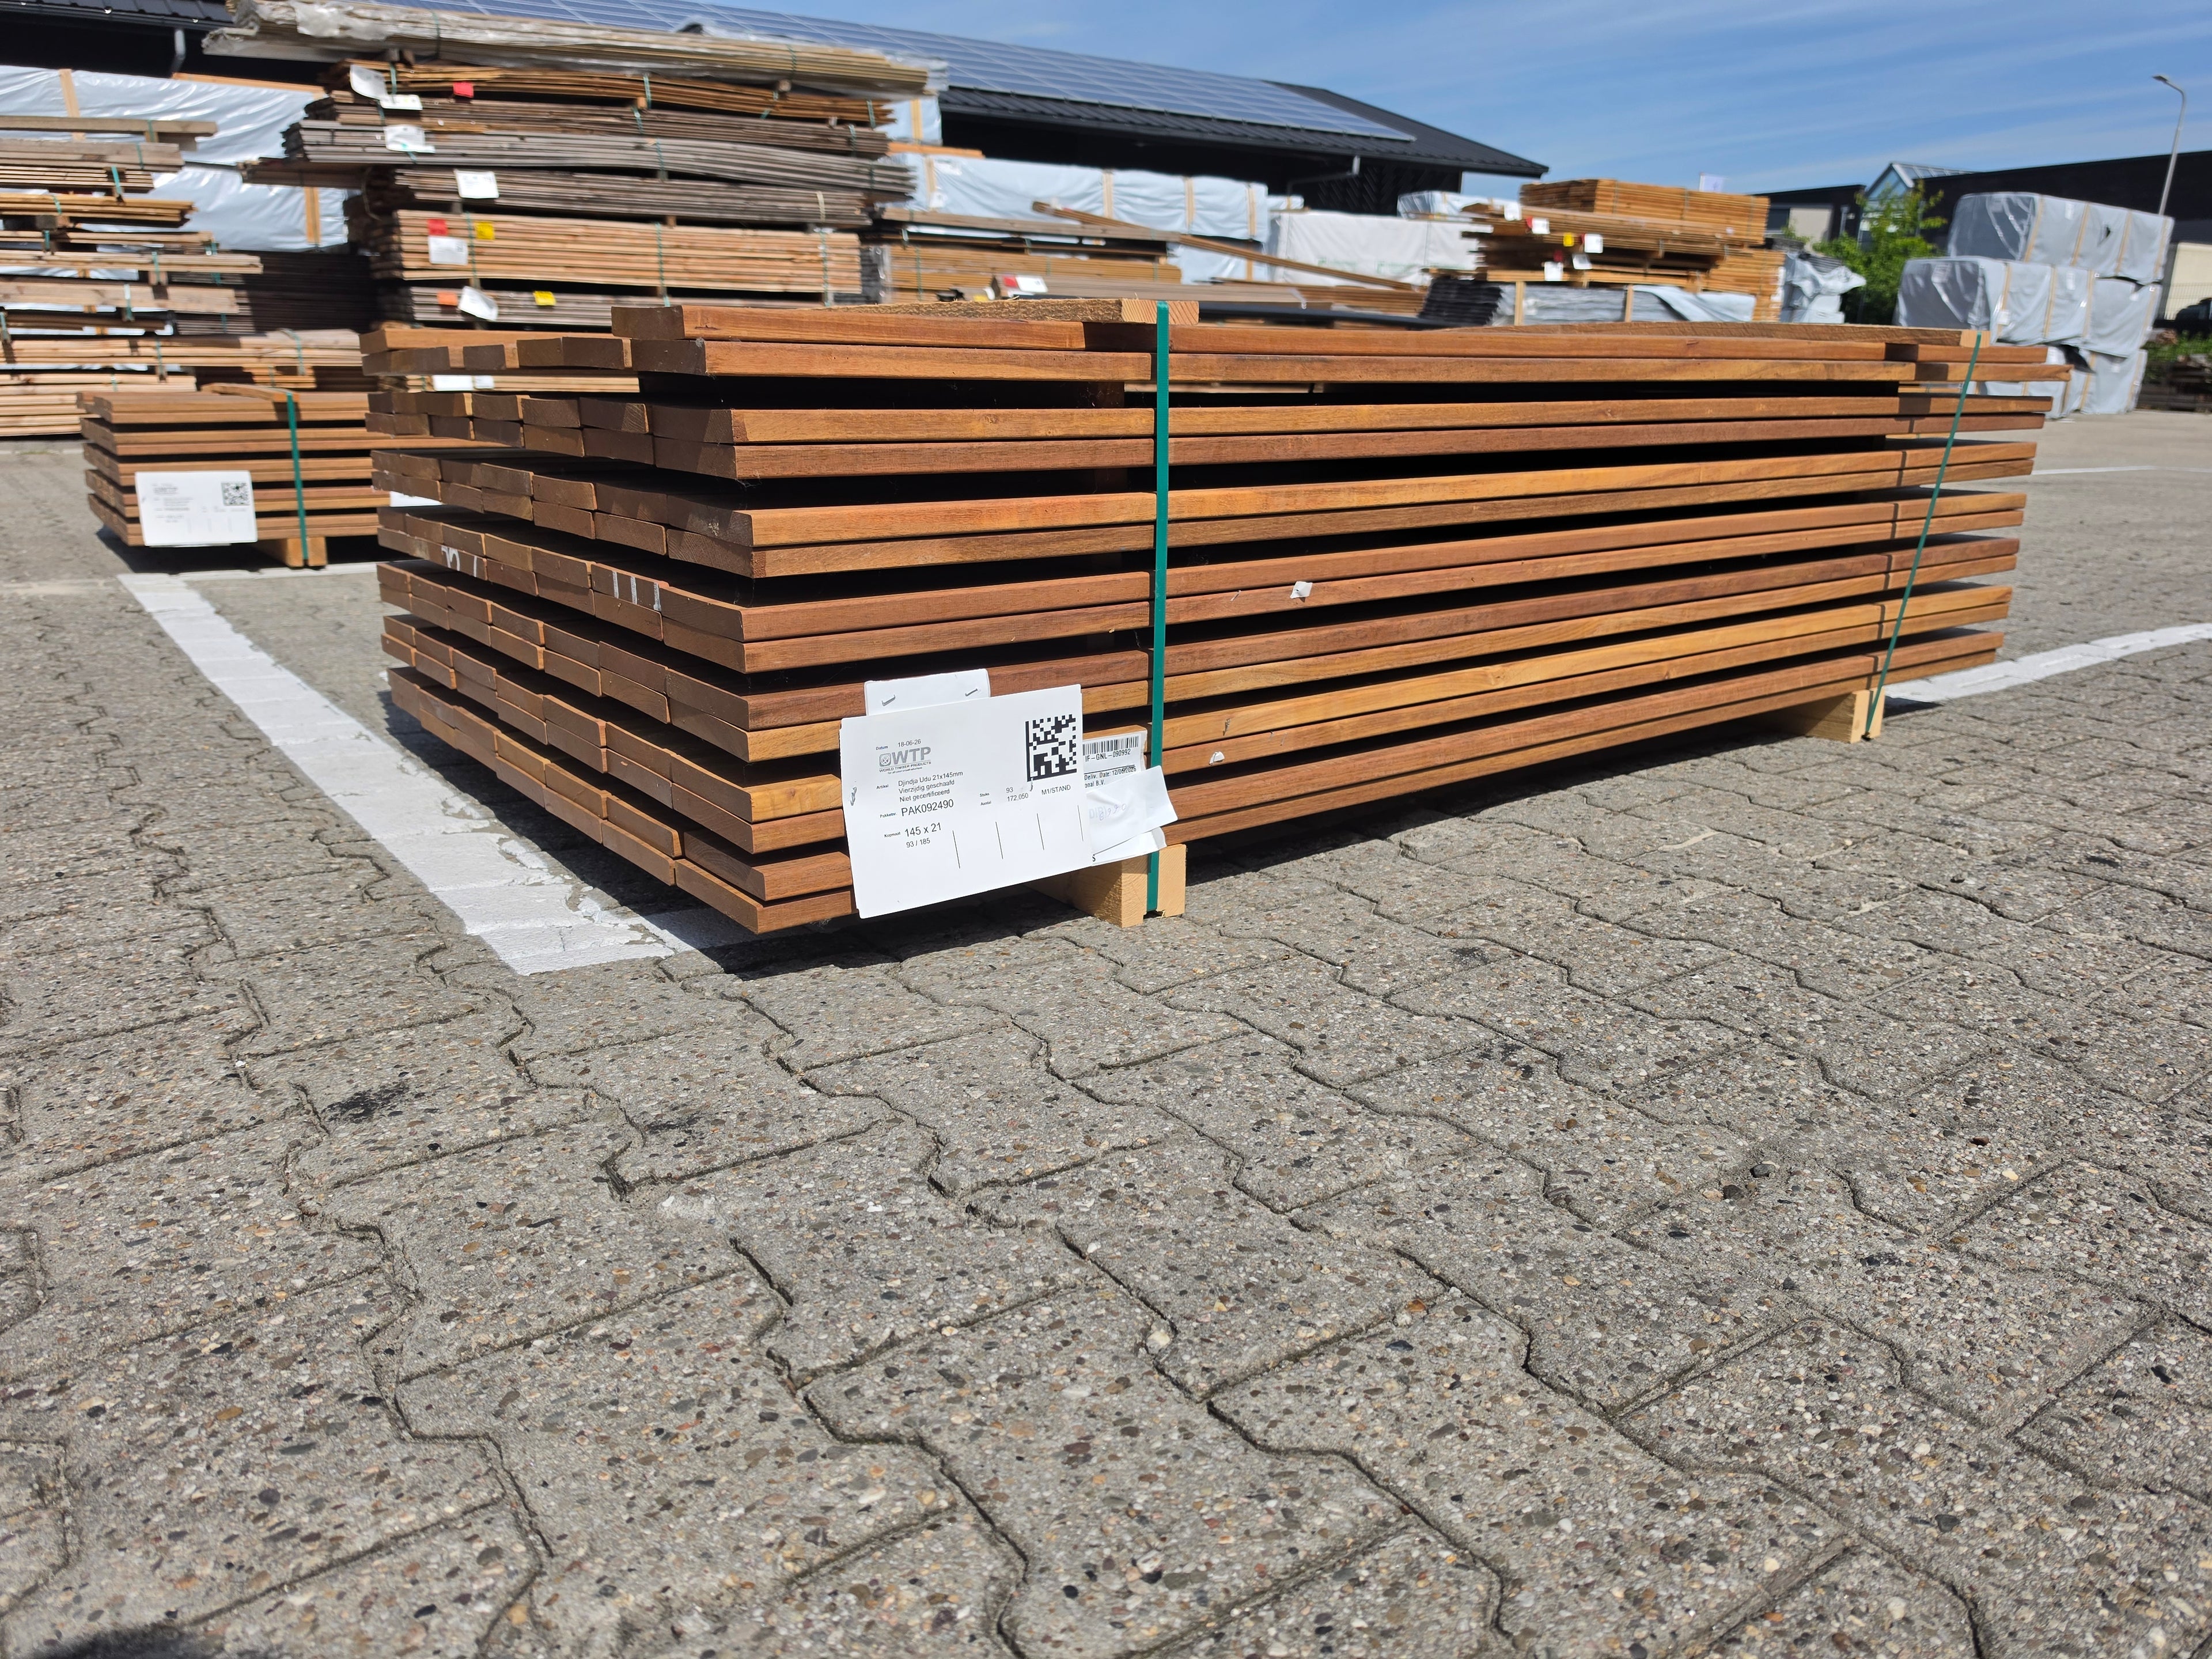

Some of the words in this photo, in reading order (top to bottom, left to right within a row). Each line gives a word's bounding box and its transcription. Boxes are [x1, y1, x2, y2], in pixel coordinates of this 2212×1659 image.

[897, 739, 921, 747] 18-06-26
[892, 747, 931, 764] WTP
[898, 778, 918, 787] Djindja
[933, 771, 963, 782] 21x145mm
[899, 785, 925, 794] Vierzijdig
[926, 779, 955, 791] geschaafd
[912, 789, 950, 801] gecertificeerd
[1041, 784, 1071, 796] M1/STAND
[901, 799, 954, 817] PAK092490
[904, 826, 921, 837] 145
[931, 822, 941, 832] 21
